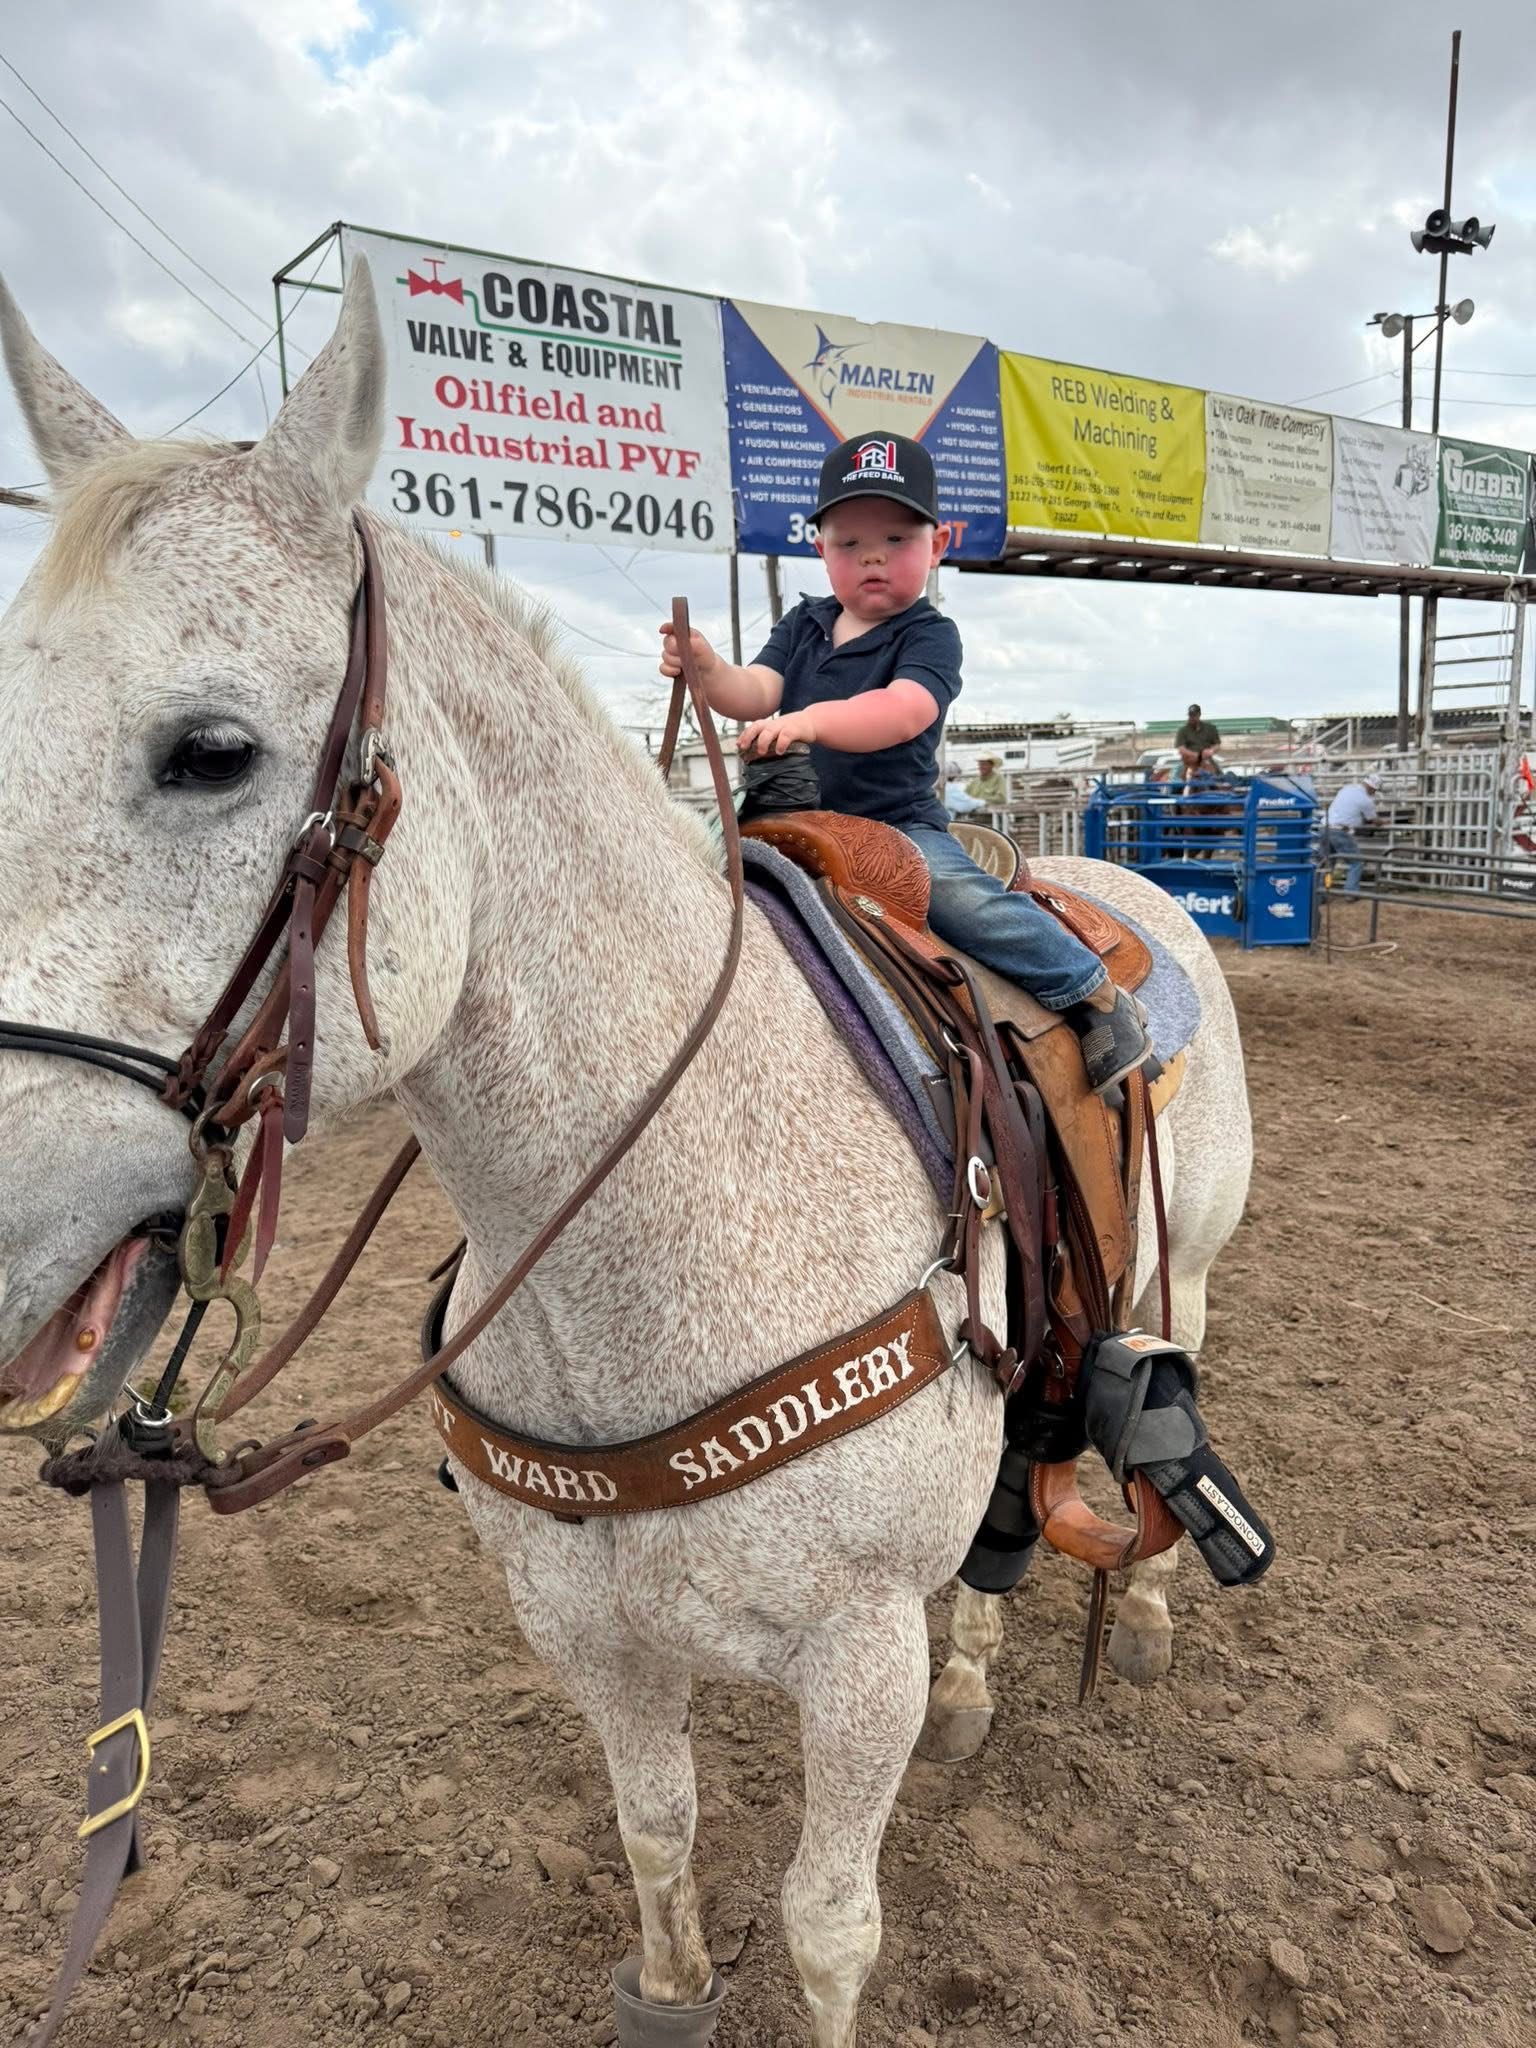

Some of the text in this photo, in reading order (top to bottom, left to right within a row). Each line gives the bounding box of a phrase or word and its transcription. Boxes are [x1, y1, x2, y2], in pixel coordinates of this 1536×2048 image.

[482, 272, 682, 347] COASTAL
[407, 320, 682, 391] VALVE & EQUIPMENT
[840, 363, 935, 395] MARLIN
[741, 384, 798, 398] VENTILATION
[435, 375, 666, 433] Oilfield and
[1052, 376, 1175, 423] REB Welding &
[742, 402, 802, 415] GENERATORS
[956, 407, 996, 419] ALIGNMENT
[744, 420, 808, 434] LIGHT TOWERS
[951, 422, 998, 435] HYDRO-TEST
[1213, 401, 1326, 442] Live Oak Title Company
[959, 438, 999, 450] EQUIPMENT
[1074, 417, 1157, 459] Machining
[396, 416, 701, 480] Industrial PVF
[745, 438, 826, 453] FUSION MACHINES
[747, 456, 764, 466] AIR
[935, 453, 963, 464] LIFTING
[971, 455, 1000, 467] RIGGING
[748, 473, 773, 485] SAND
[776, 475, 801, 486] BLAST
[804, 476, 811, 487] &
[842, 471, 905, 483] THE FEED BARN
[967, 473, 1000, 483] BEVELING
[1442, 448, 1523, 500] GOEBEL
[750, 492, 769, 502] HOT
[770, 493, 811, 504] PRESSURE
[964, 488, 1000, 499] GROOVING
[390, 468, 714, 541] 361-786-2046
[960, 504, 1000, 515] INSPECTION
[669, 1330, 913, 1490] SADDLERY
[481, 1438, 619, 1502] WARD
[1204, 1484, 1263, 1552] ICONOCLAST
